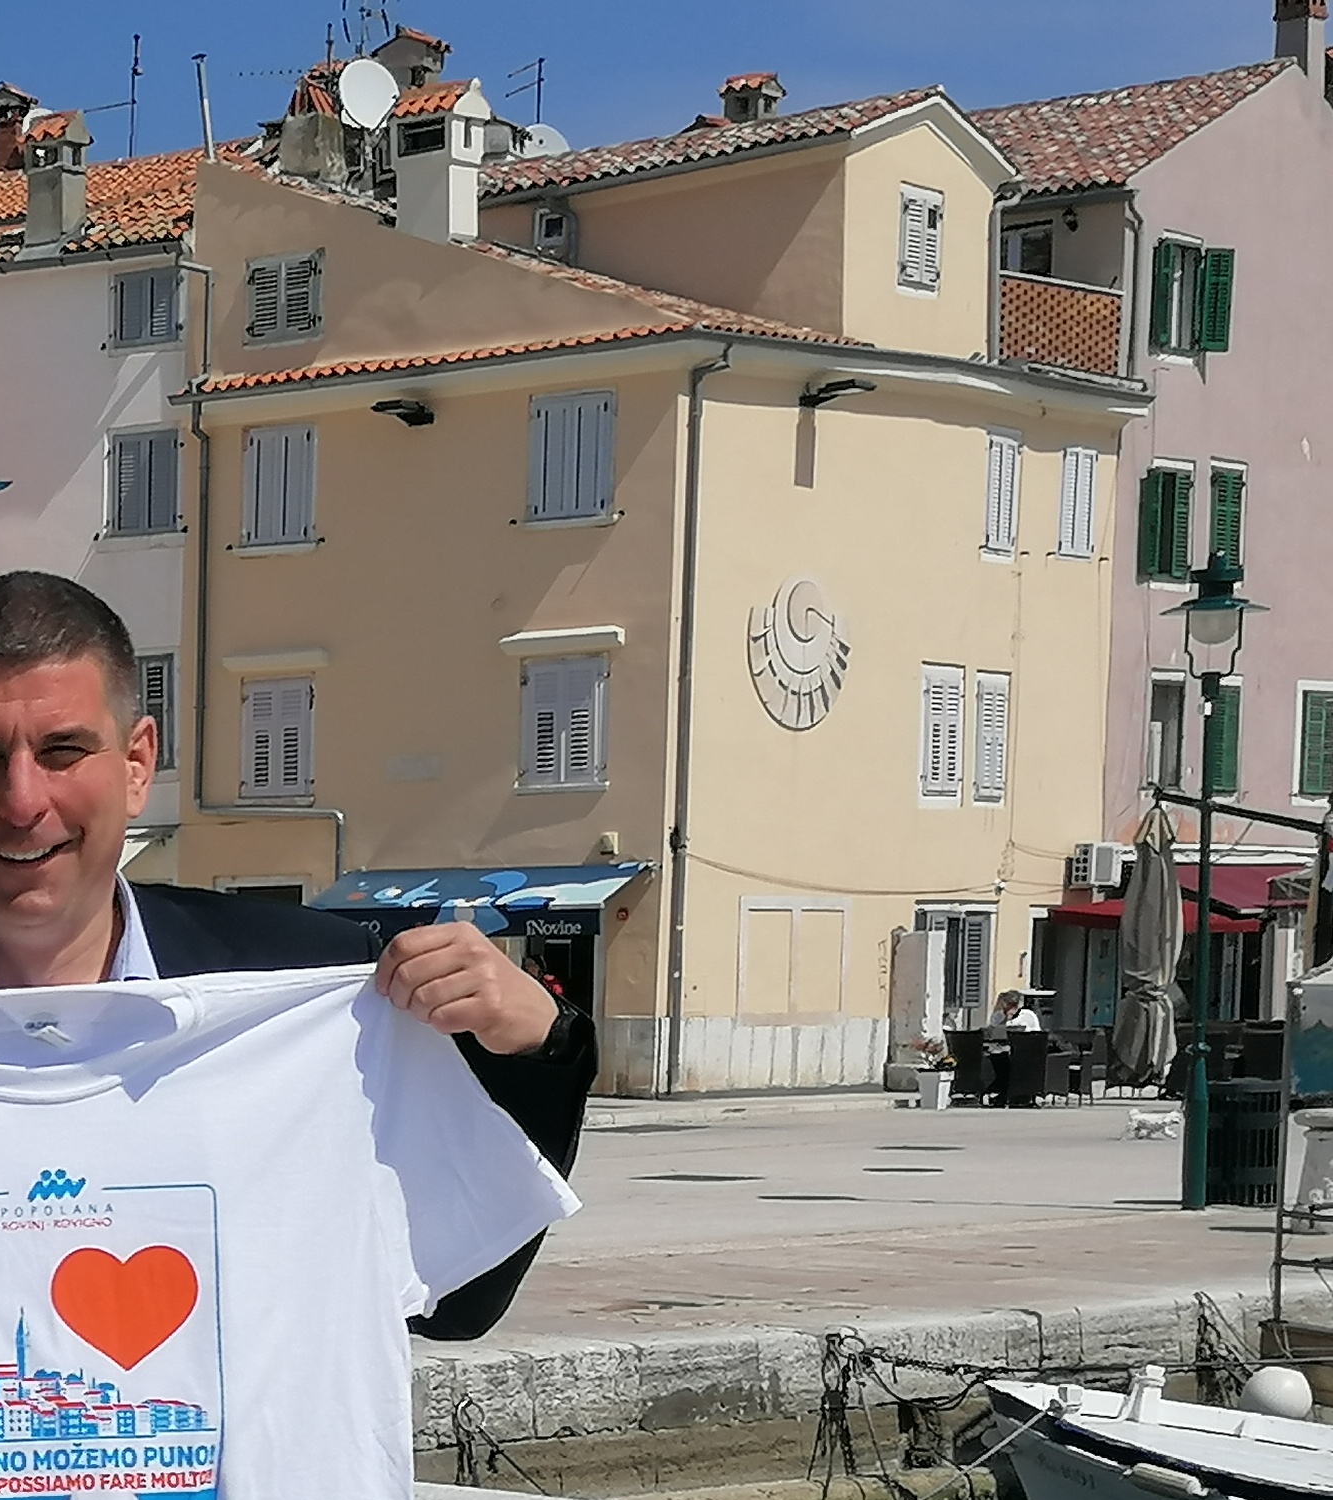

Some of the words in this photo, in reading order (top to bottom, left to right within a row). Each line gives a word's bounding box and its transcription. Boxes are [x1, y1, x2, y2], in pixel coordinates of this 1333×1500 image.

[0, 1203, 113, 1217] POPOLANA
[33, 1442, 137, 1470] MOŽEMO
[144, 1445, 216, 1468] PUNO!
[99, 1472, 147, 1490] FARE
